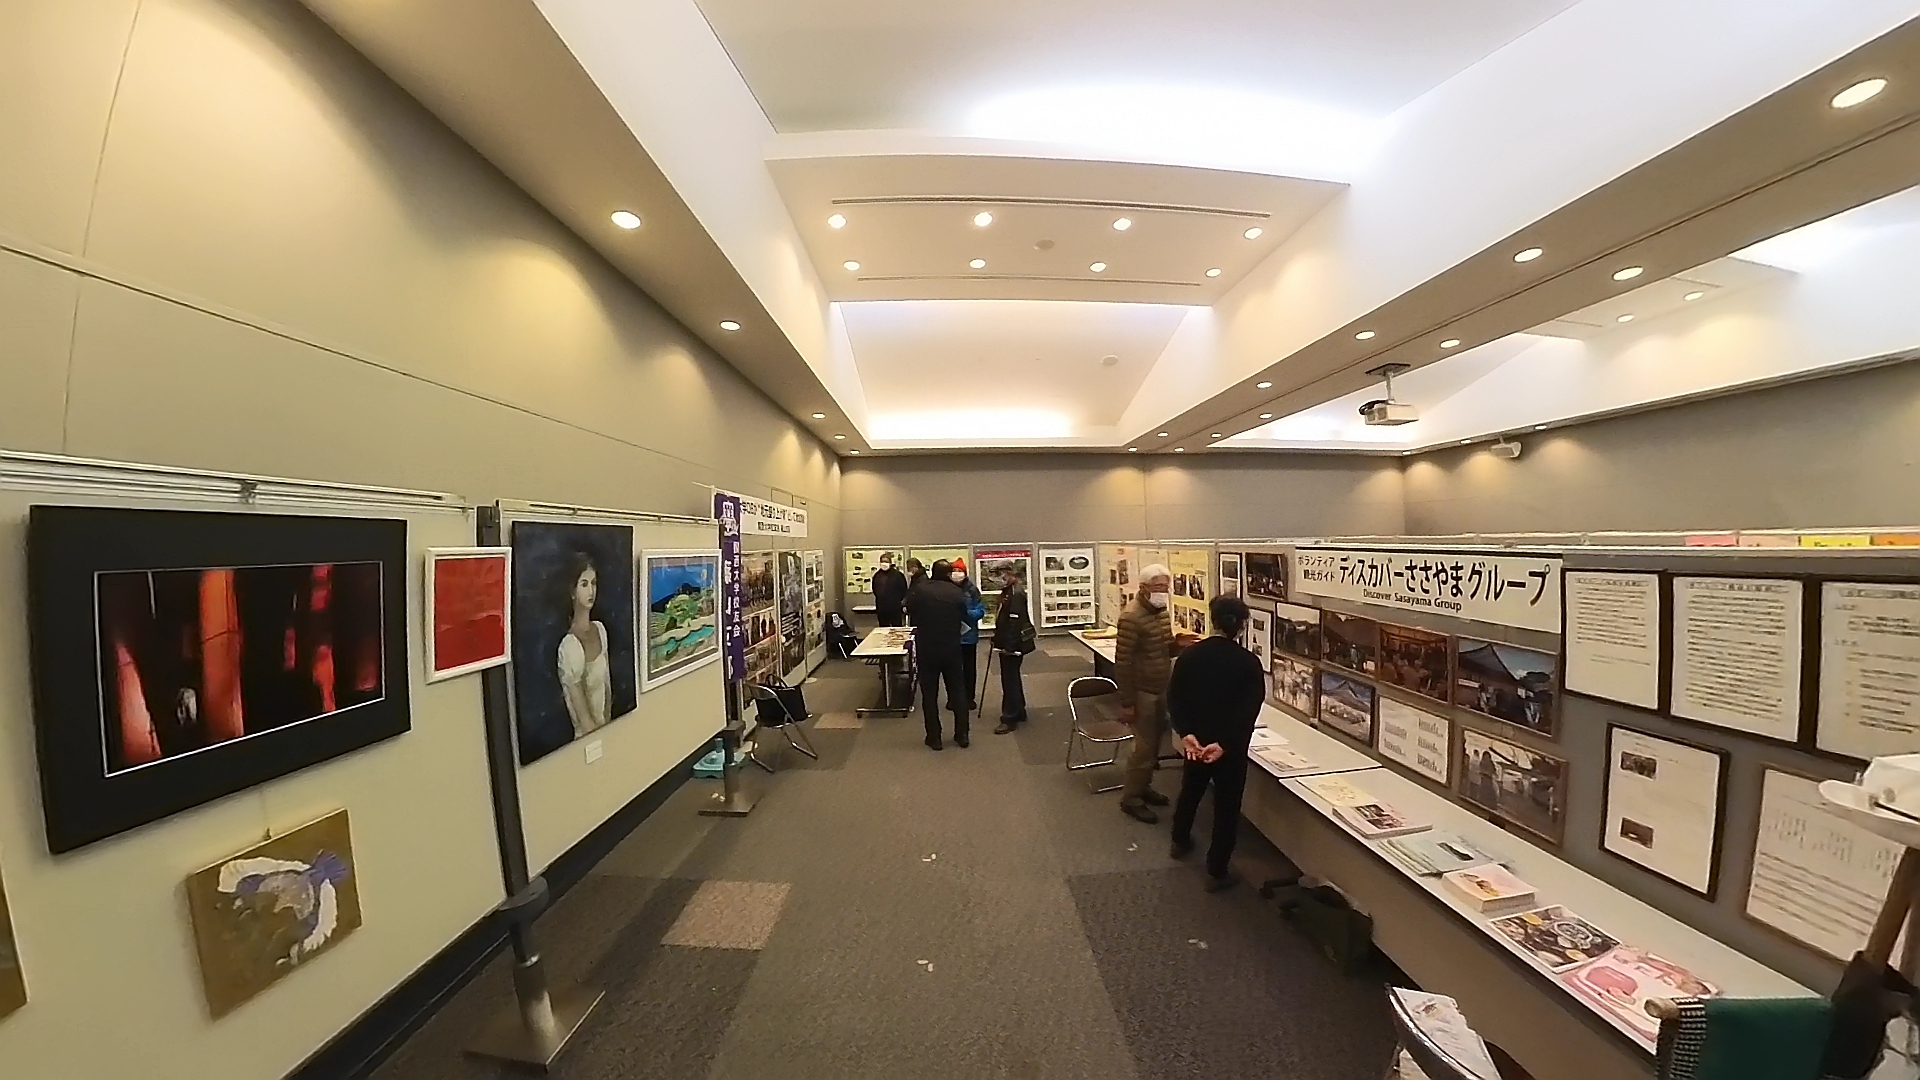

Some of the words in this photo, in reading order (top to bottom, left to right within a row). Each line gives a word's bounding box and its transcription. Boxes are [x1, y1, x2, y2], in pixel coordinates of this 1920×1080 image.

[1297, 555, 1335, 567] ボランティア
[1303, 569, 1335, 582] 観光ガイド
[1338, 555, 1551, 607] ディスカバーささやまグループ
[1363, 588, 1392, 601] Discover
[1394, 592, 1432, 607] Sasayama
[1434, 597, 1462, 613] Group
